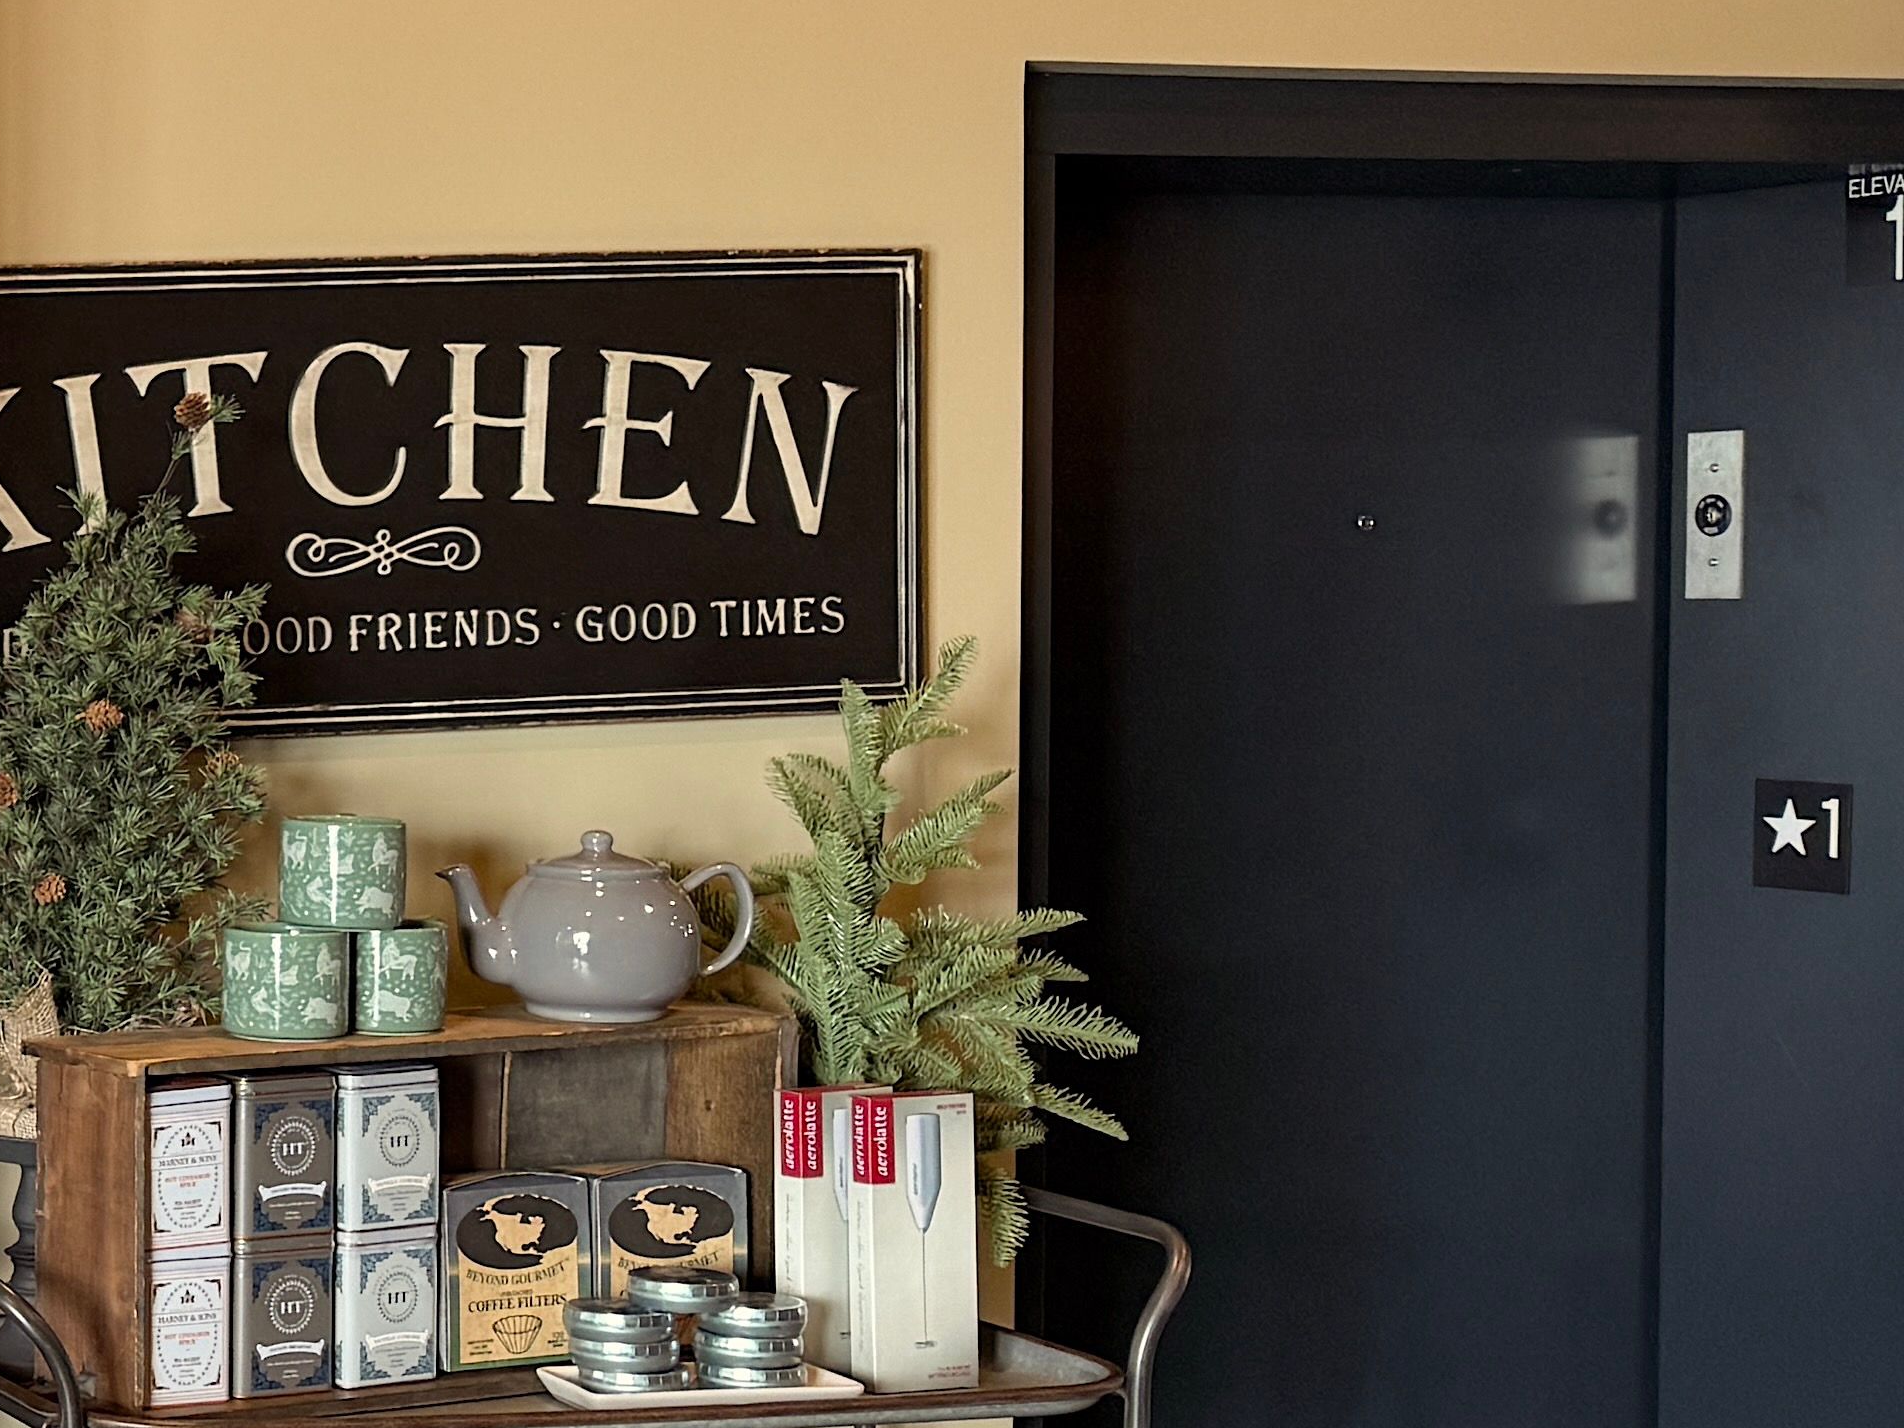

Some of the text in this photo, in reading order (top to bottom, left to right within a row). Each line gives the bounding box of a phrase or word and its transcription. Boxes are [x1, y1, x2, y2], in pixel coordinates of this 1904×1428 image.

[240, 614, 334, 658] OOD
[348, 606, 540, 654] FRIENDS
[575, 600, 696, 645] GOOD
[709, 596, 846, 640] TIMES
[1820, 798, 1840, 859] 1
[785, 1099, 794, 1170] aerolatte
[804, 1101, 817, 1171] aerolatte
[855, 1104, 865, 1176] aerolatte
[877, 1106, 888, 1178] aerolatte
[466, 1262, 565, 1286] BEYOND GOURMET
[468, 1294, 568, 1314] COFFEE FILTERS
